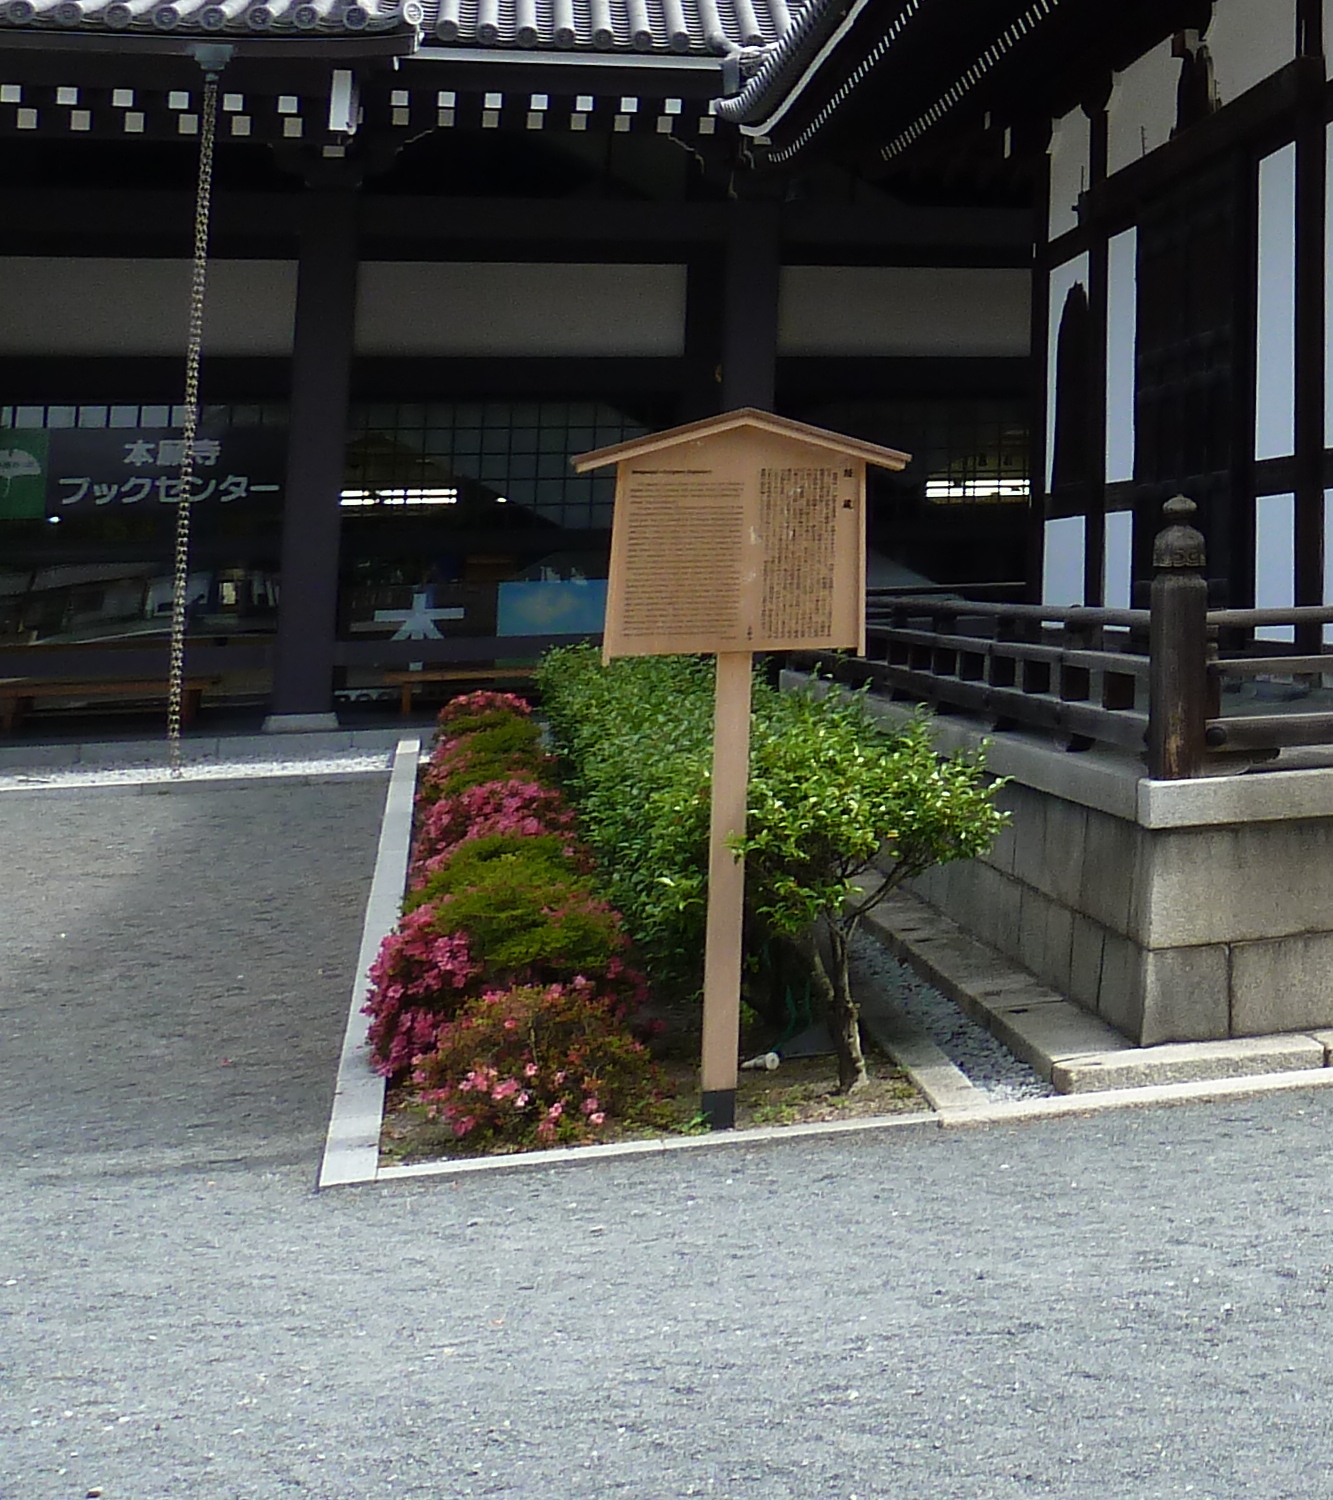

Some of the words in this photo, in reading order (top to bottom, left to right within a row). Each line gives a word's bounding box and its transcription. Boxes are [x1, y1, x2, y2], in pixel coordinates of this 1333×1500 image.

[58, 475, 281, 505] ブックセンター
